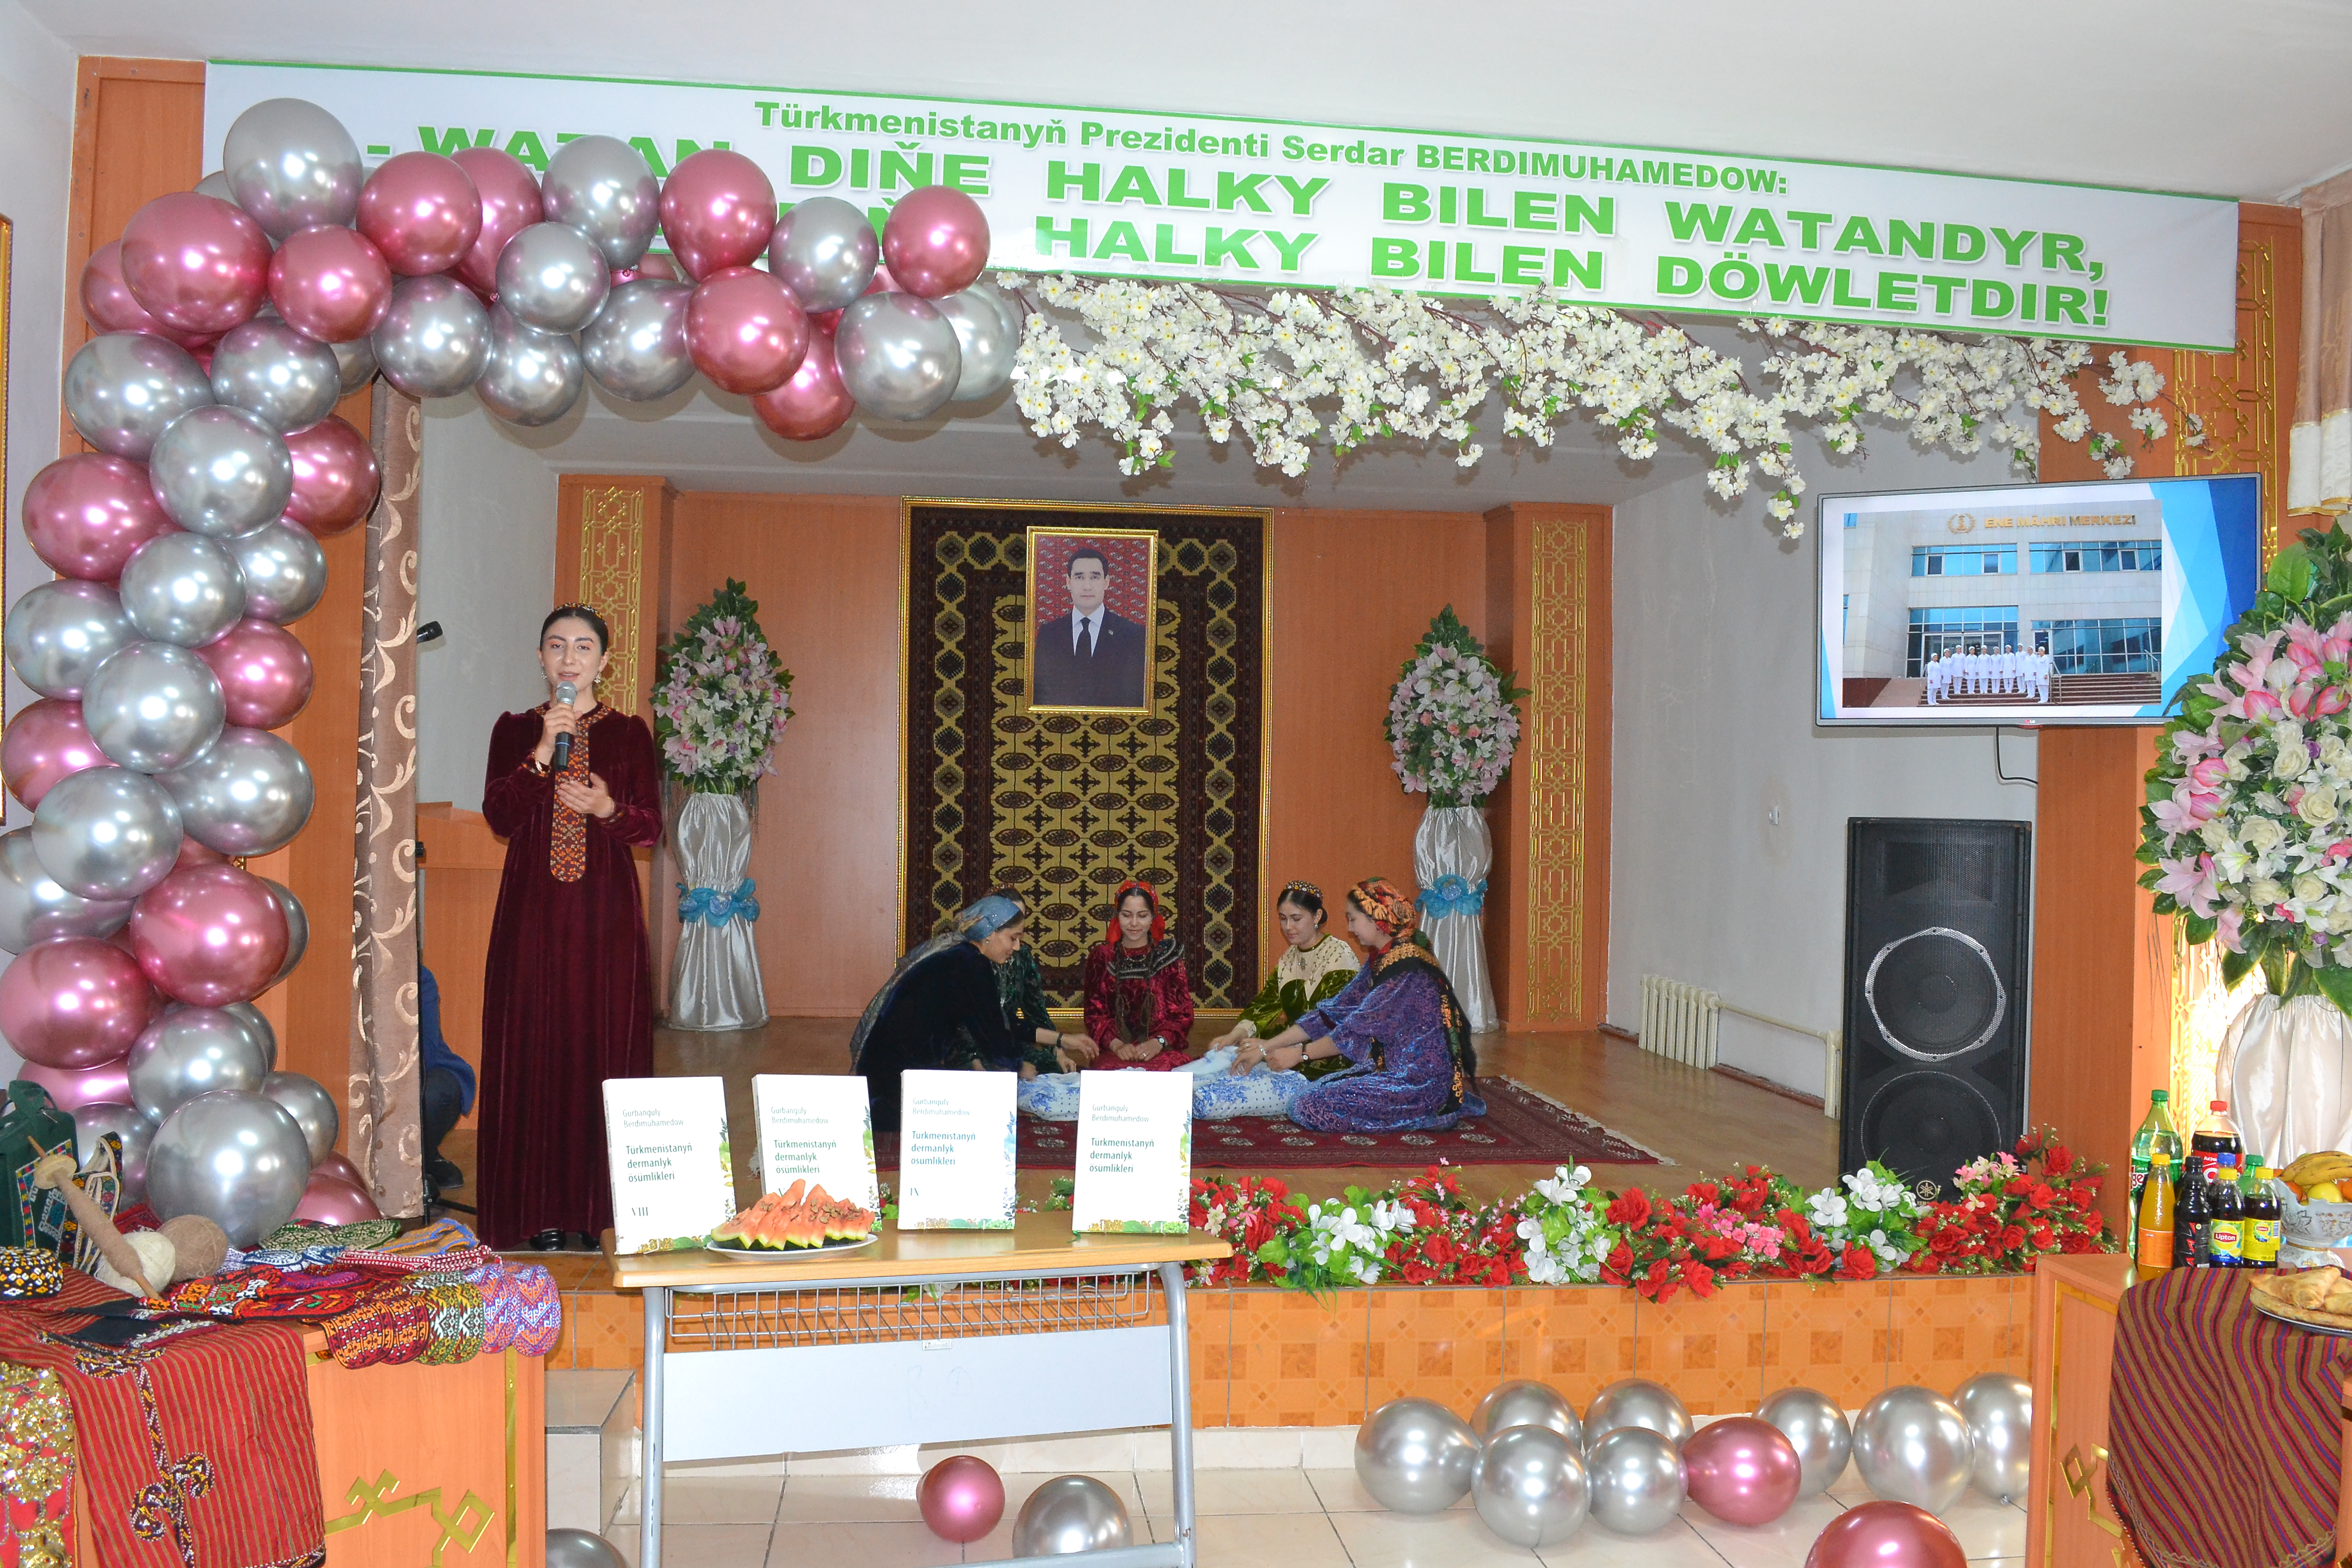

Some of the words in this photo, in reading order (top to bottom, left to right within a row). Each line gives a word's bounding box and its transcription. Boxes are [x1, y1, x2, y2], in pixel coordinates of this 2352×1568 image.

[755, 102, 1066, 148] Türkmenistanyň
[1082, 122, 1268, 156] Prezidenti
[1283, 136, 1405, 165] Serdar
[1418, 145, 1786, 193] BERDIMUHAMEDOW:
[792, 142, 989, 194] DIŇE
[1048, 161, 1329, 215] HALKY
[1384, 183, 1613, 234] BILEN
[1666, 202, 2103, 281] WATANDYR,
[1037, 216, 1316, 270] HALKY
[1372, 238, 1602, 288] BILEN
[1657, 252, 2108, 325] DÖWLETDIR!
[1985, 518, 2014, 528] ENE
[2069, 515, 2136, 526] MERKEZI
[913, 1097, 949, 1106] Gurbanguly
[623, 1108, 660, 1118] Gurbanguly
[771, 1107, 806, 1115] Gurbanguly
[913, 1107, 970, 1115] Berdimuhamedow
[1092, 1104, 1129, 1113] Gurbanguly
[624, 1118, 684, 1128] Berdimuhamedow
[1092, 1114, 1149, 1122] Berdimuhamedow
[912, 1131, 975, 1142] Türkmenistanyň
[626, 1142, 692, 1154] Türkmenistanyň
[774, 1140, 837, 1150] Türkmenistanyň
[911, 1143, 953, 1154] dermanlyk
[1091, 1138, 1154, 1149] Türkmenistanyň
[775, 1152, 817, 1163] dermanlyk
[911, 1156, 955, 1165] ösümlikleri
[1090, 1150, 1132, 1162] dermanlyk
[627, 1157, 672, 1168] dermanlyk
[1089, 1163, 1133, 1172] ösümlikleri
[776, 1165, 820, 1173] ösümlikleri
[628, 1171, 675, 1182] ösümlikleri
